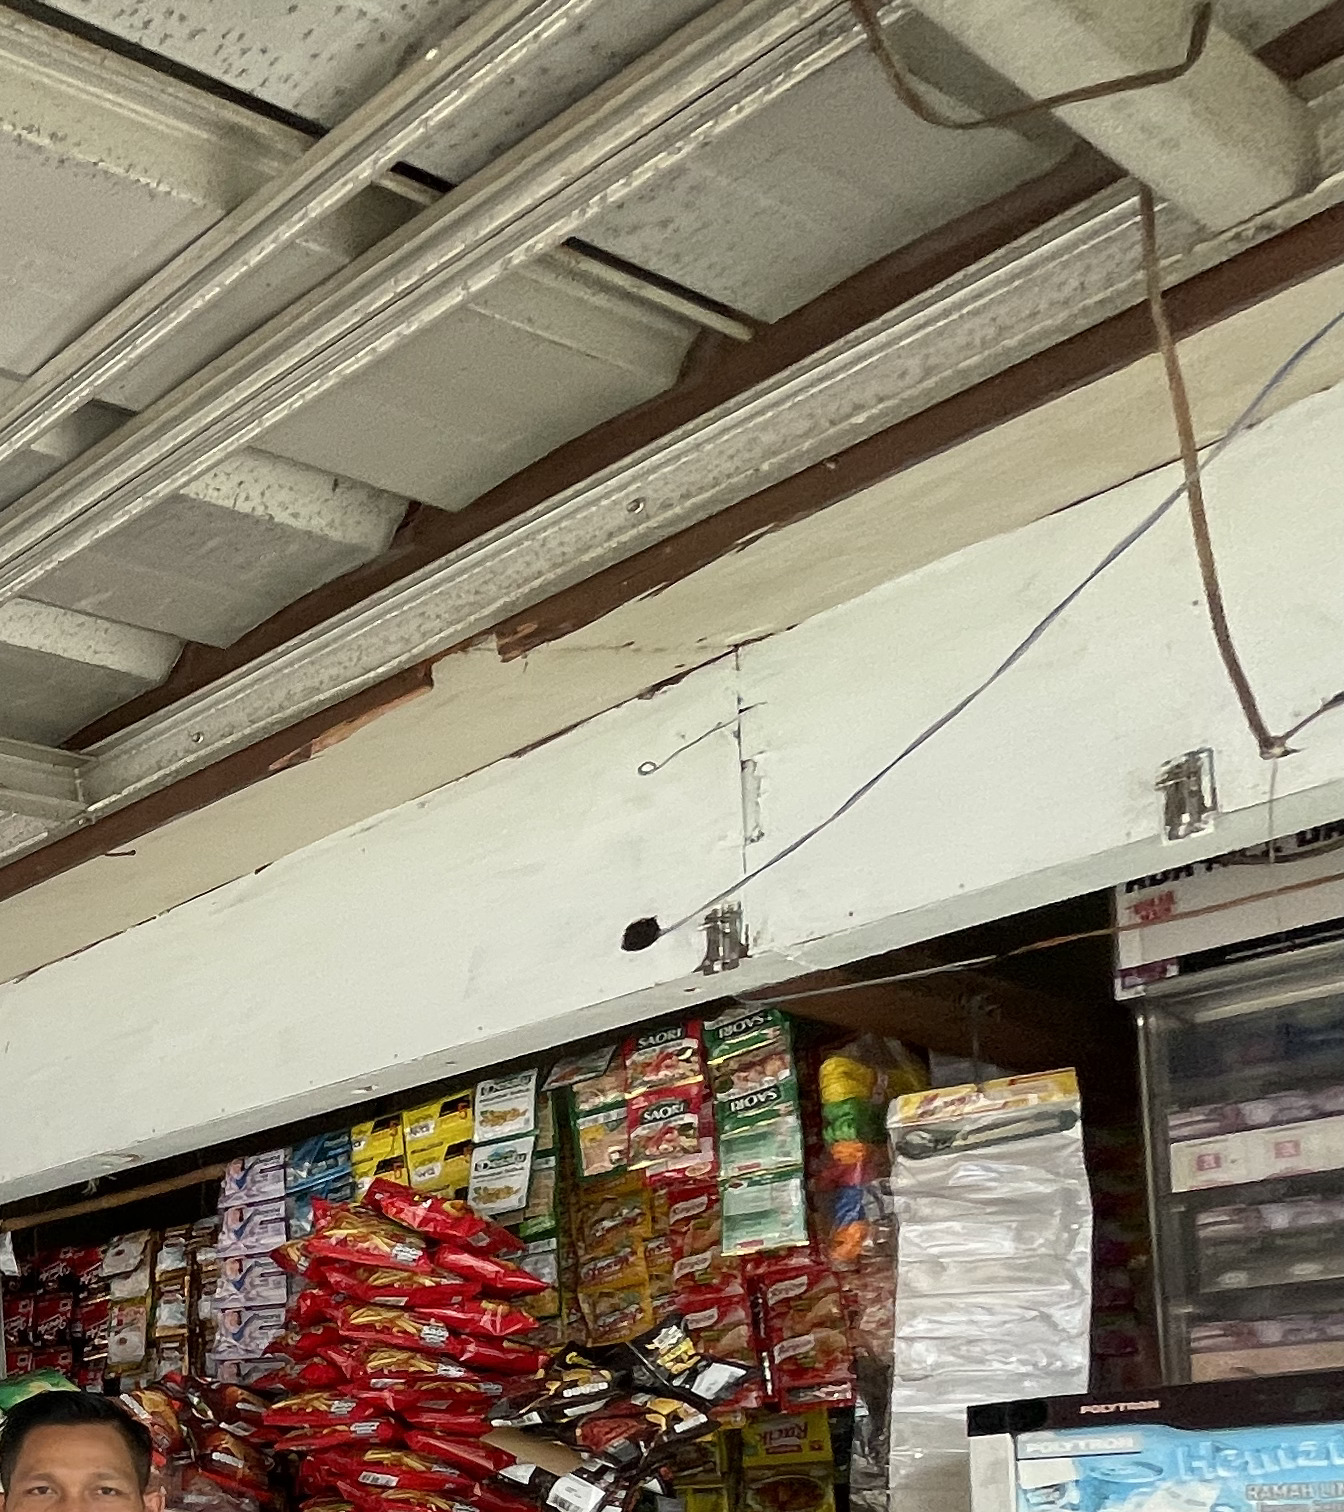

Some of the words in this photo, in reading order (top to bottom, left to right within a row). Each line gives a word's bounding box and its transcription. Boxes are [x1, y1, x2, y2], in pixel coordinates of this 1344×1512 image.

[636, 1026, 683, 1049] SAORI
[717, 1013, 765, 1040] SAORI
[729, 1087, 778, 1113] SAORI
[642, 1101, 686, 1124] SAORI
